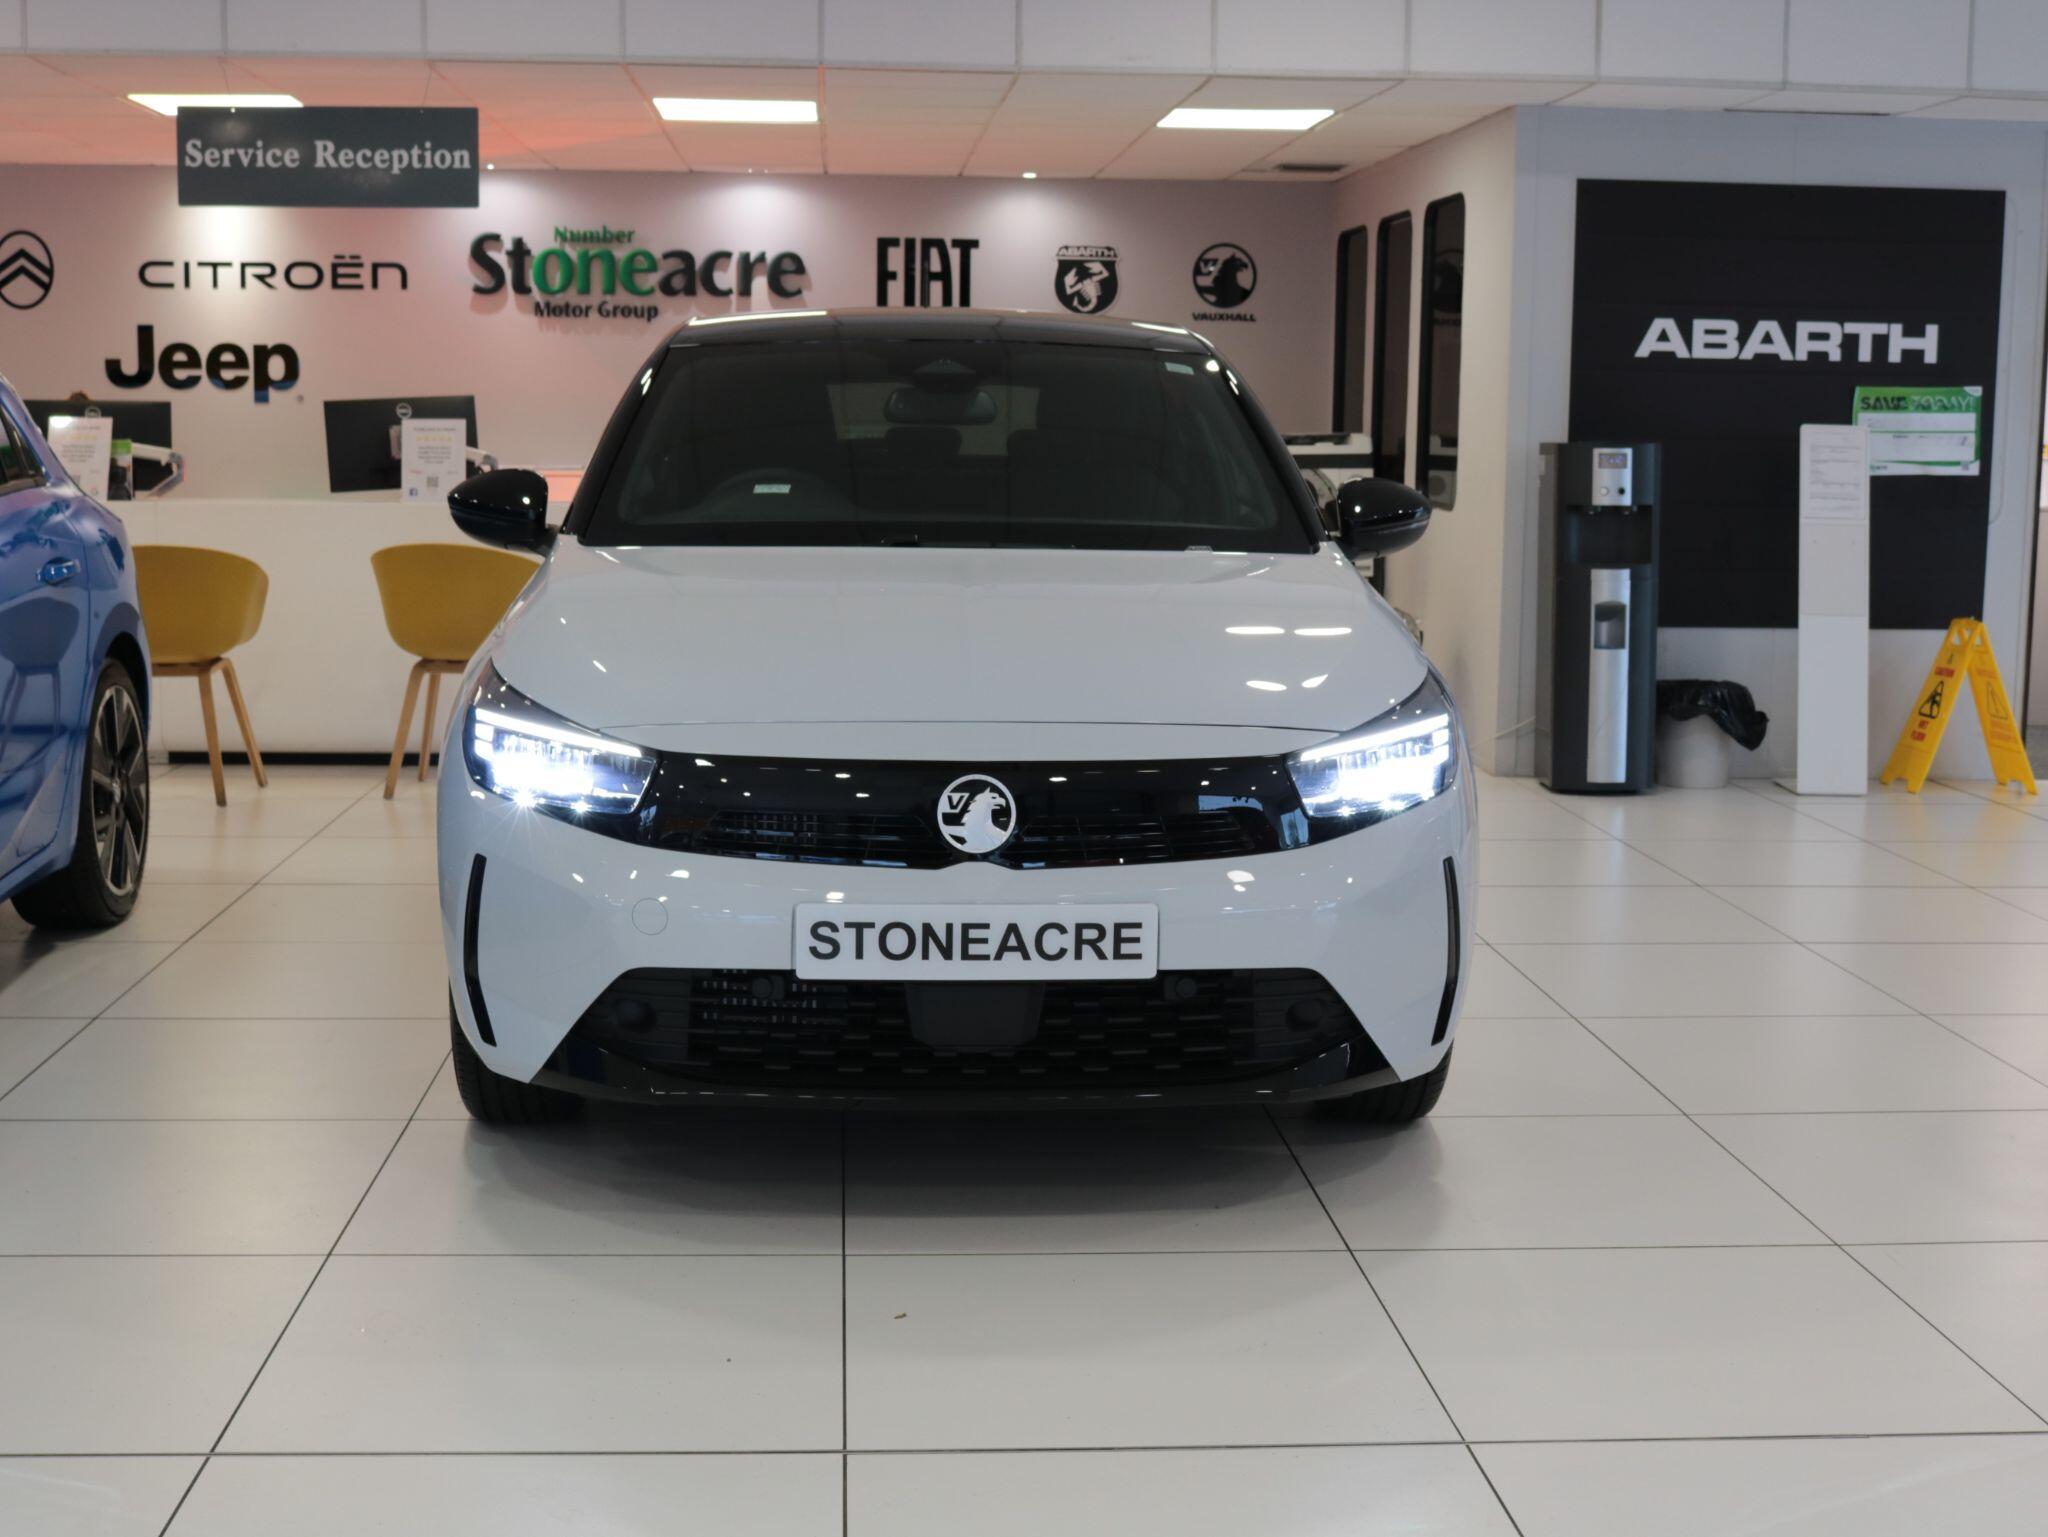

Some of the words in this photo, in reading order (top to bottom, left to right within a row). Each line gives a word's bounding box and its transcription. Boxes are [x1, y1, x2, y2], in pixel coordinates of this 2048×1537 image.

[185, 139, 300, 168] Service
[314, 140, 471, 175] Reception
[554, 226, 635, 244] Number
[1058, 248, 1116, 258] ABARTH
[470, 232, 807, 298] Stoneacre
[877, 237, 979, 307] FIAT
[534, 300, 592, 319] Motor
[597, 300, 659, 322] Group
[1192, 312, 1257, 322] VAUXHALL
[1634, 317, 1939, 364] ABARTH
[105, 324, 300, 404] Jeep
[808, 921, 1143, 962] STONEACRE
